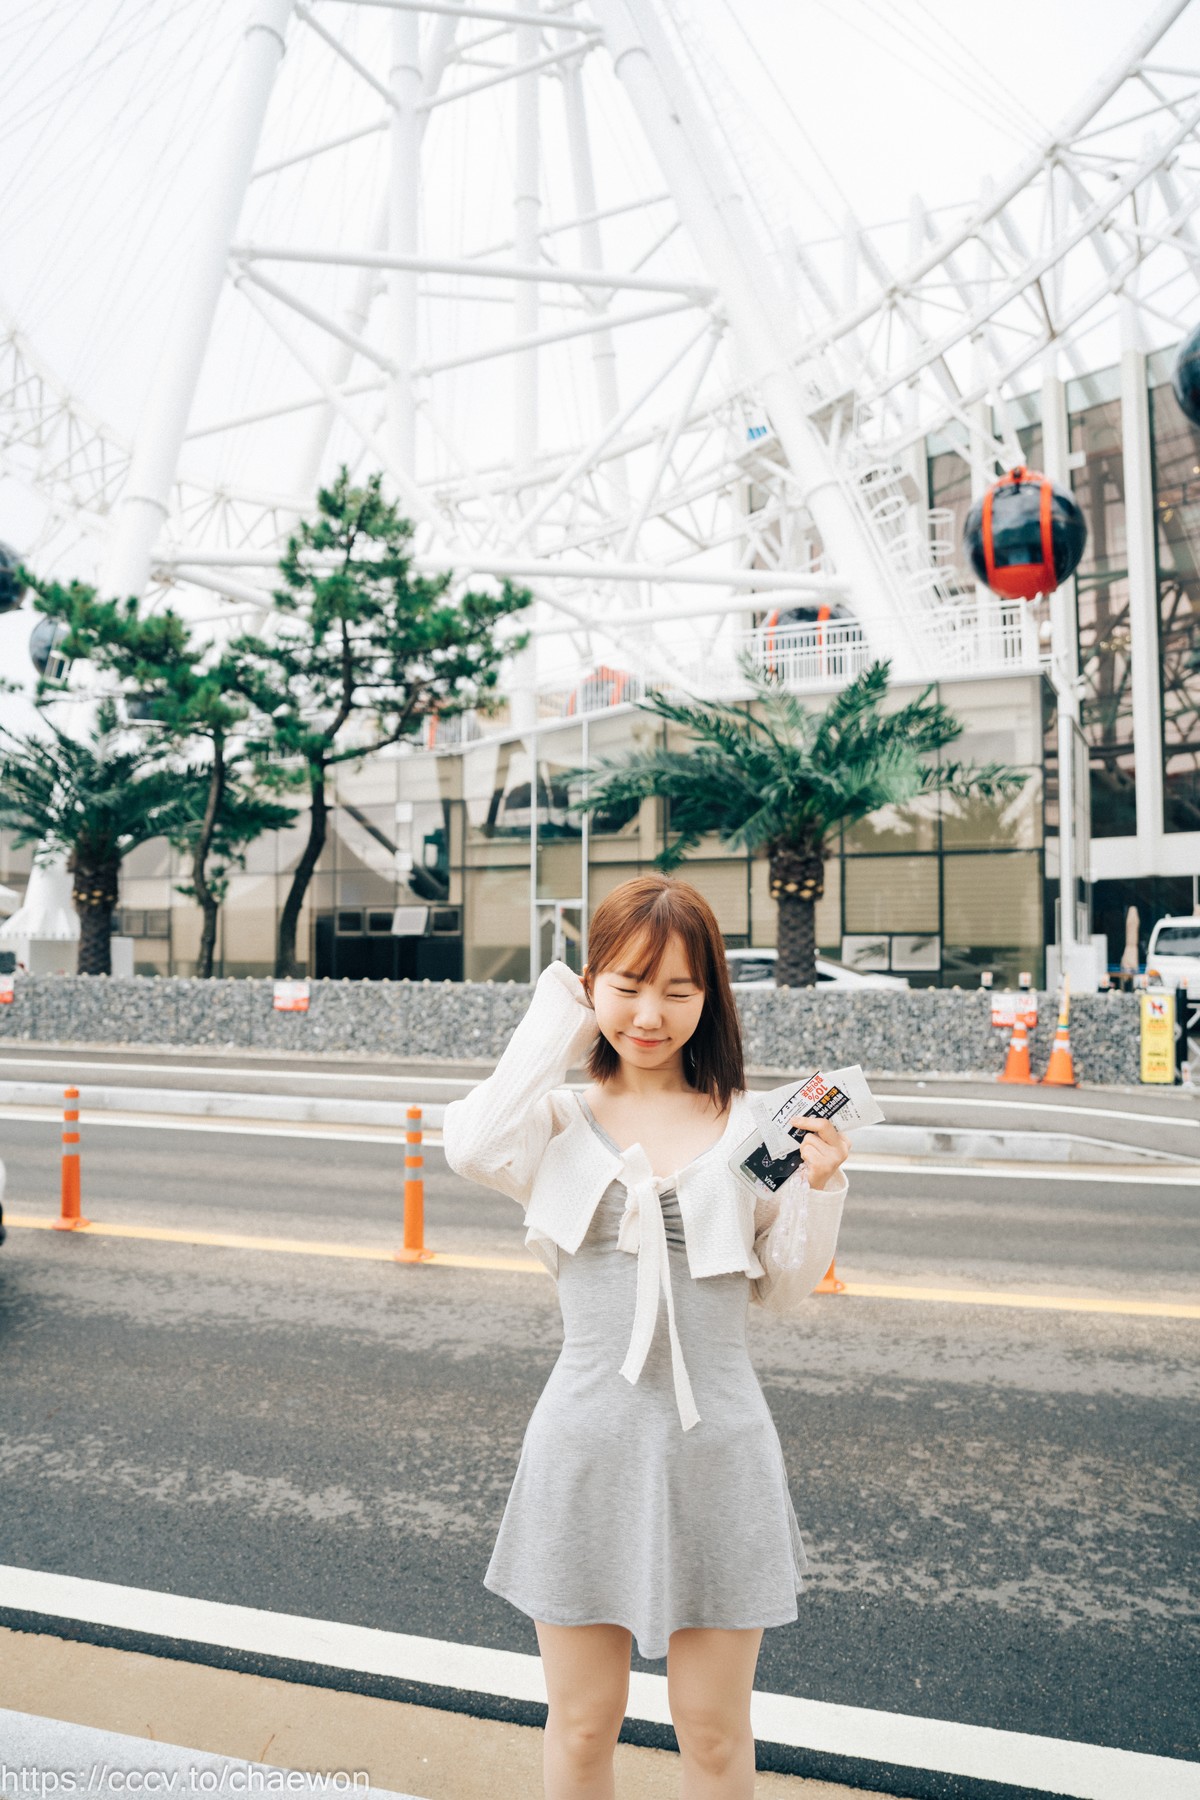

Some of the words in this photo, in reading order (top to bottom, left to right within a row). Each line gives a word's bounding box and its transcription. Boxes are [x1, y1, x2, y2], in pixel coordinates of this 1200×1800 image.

[800, 1075, 824, 1098] 할인쿠폰
[807, 1084, 829, 1102] 10%
[764, 1175, 777, 1190] VISA
